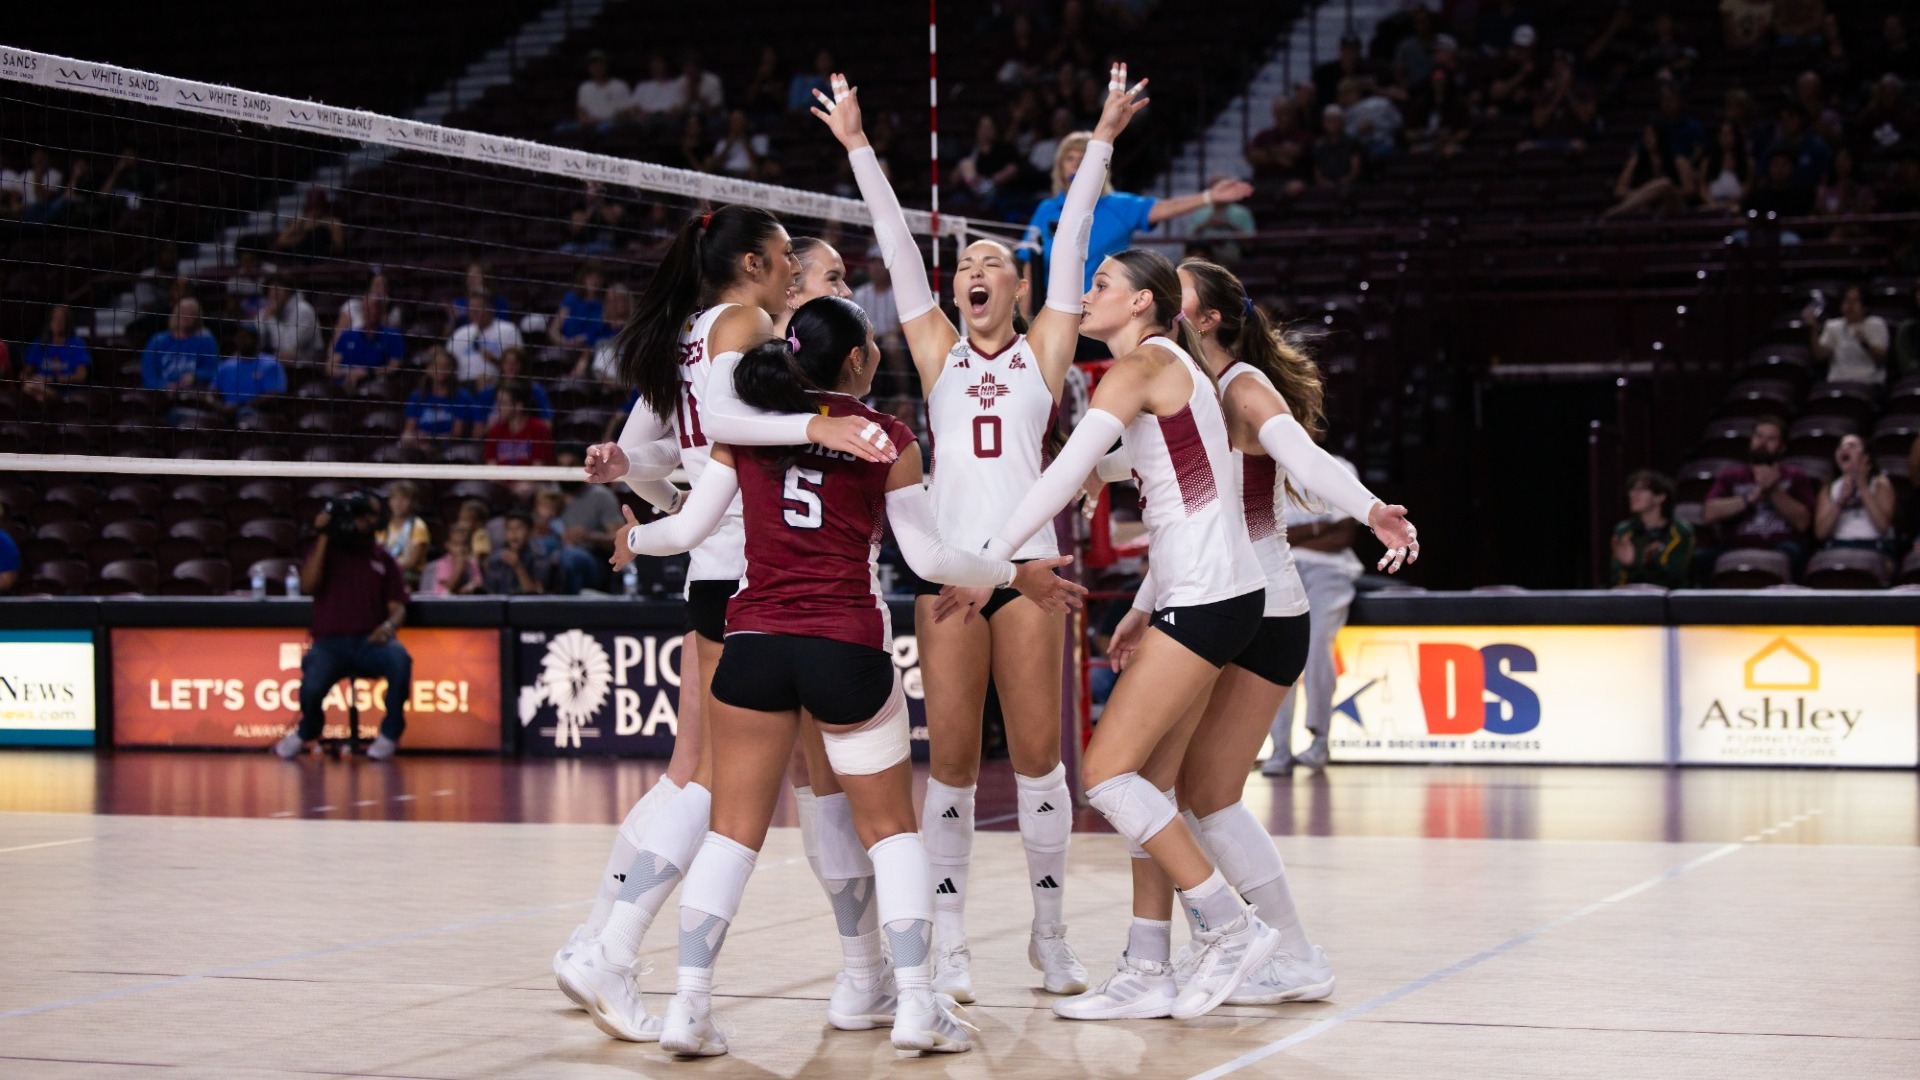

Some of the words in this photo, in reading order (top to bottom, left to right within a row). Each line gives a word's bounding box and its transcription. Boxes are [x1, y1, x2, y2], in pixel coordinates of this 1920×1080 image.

[3, 53, 37, 70] SANDS
[92, 68, 123, 86] WHITE
[129, 76, 160, 92] SANDS
[208, 89, 237, 107] WHITE
[243, 96, 271, 113] SANDS
[316, 109, 342, 125] WHITE
[346, 115, 372, 131] SANDS
[413, 126, 438, 142] WHITE
[441, 132, 466, 147] SANDS
[973, 415, 1002, 458] 0
[782, 465, 824, 530] 5
[150, 678, 245, 711] LET'S
[1698, 697, 1863, 739] Ashley
[1388, 740, 1466, 749] DOCUMENT
[1472, 740, 1541, 749] SERVICES
